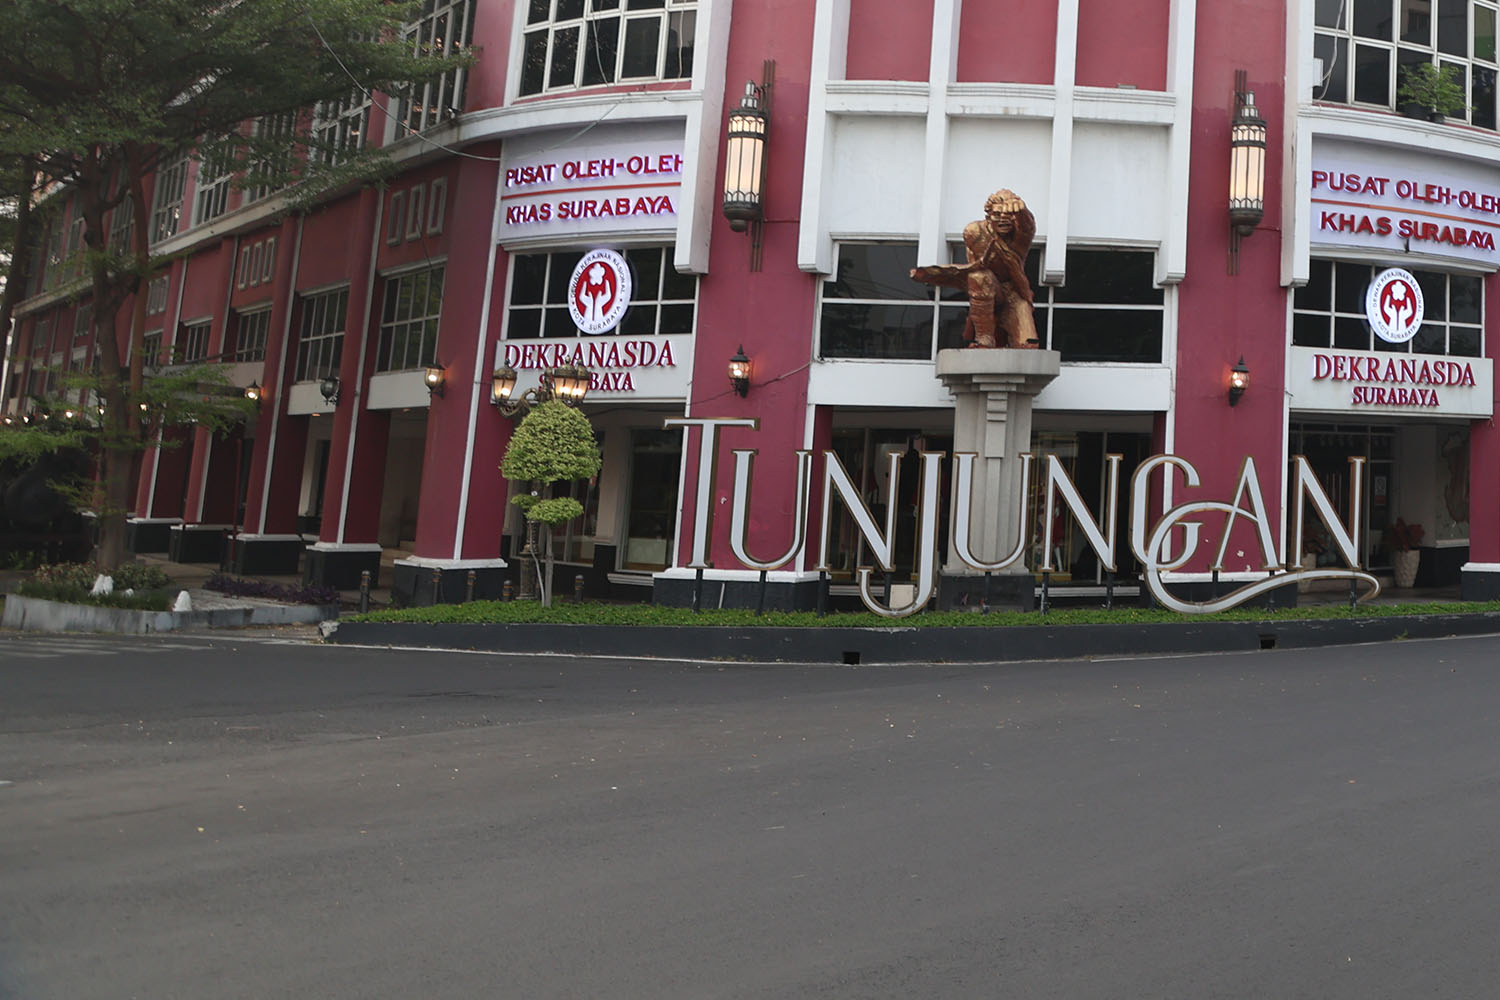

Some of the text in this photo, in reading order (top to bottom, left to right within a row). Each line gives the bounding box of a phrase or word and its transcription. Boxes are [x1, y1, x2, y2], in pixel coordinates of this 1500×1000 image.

[505, 154, 683, 188] PUSAT OLEH-OLEH
[1311, 170, 1390, 196] PUSAT
[505, 195, 675, 225] KHAS SURABAYA
[1320, 211, 1496, 251] KHAS SURABAYA
[504, 339, 676, 369] DEKRANASDA
[539, 371, 635, 392] SBAYA
[1313, 354, 1476, 387] DEKRANASDA
[1352, 386, 1440, 407] SURABAYA
[663, 417, 1381, 616] TUNJUNGAN
